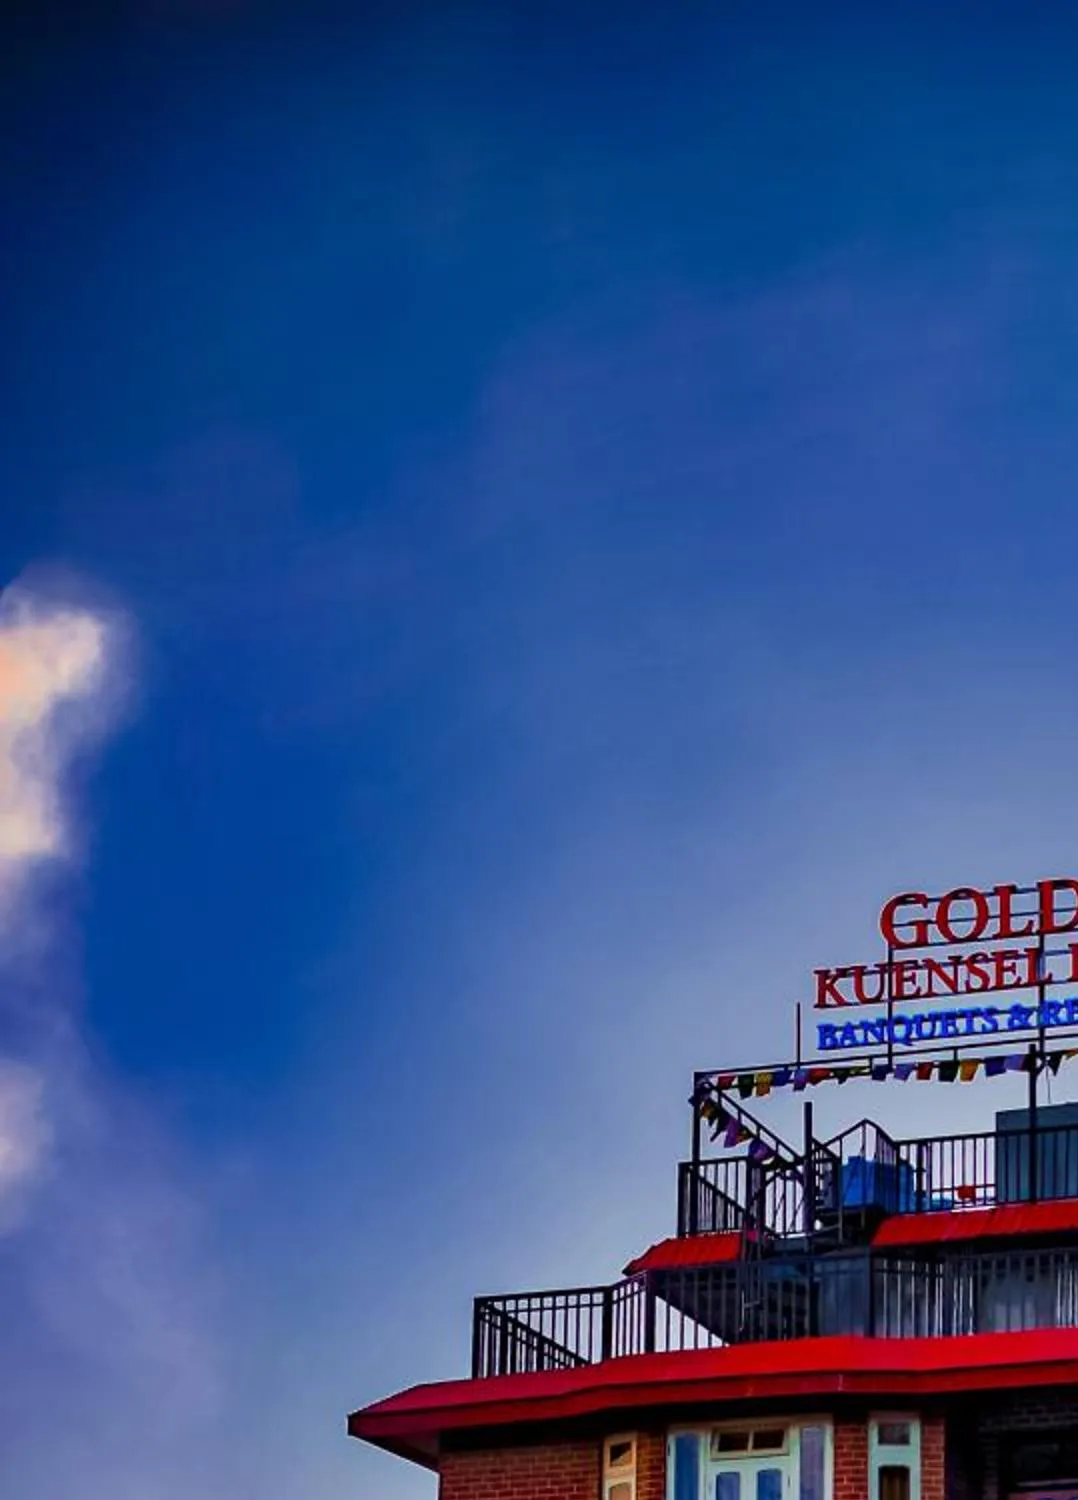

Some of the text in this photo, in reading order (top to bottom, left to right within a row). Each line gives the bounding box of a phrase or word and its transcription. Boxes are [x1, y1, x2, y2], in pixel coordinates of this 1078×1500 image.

[813, 946, 1053, 1009] KUENSEL
[816, 1006, 998, 1051] BANQUETS
[1007, 1003, 1033, 1030] &
